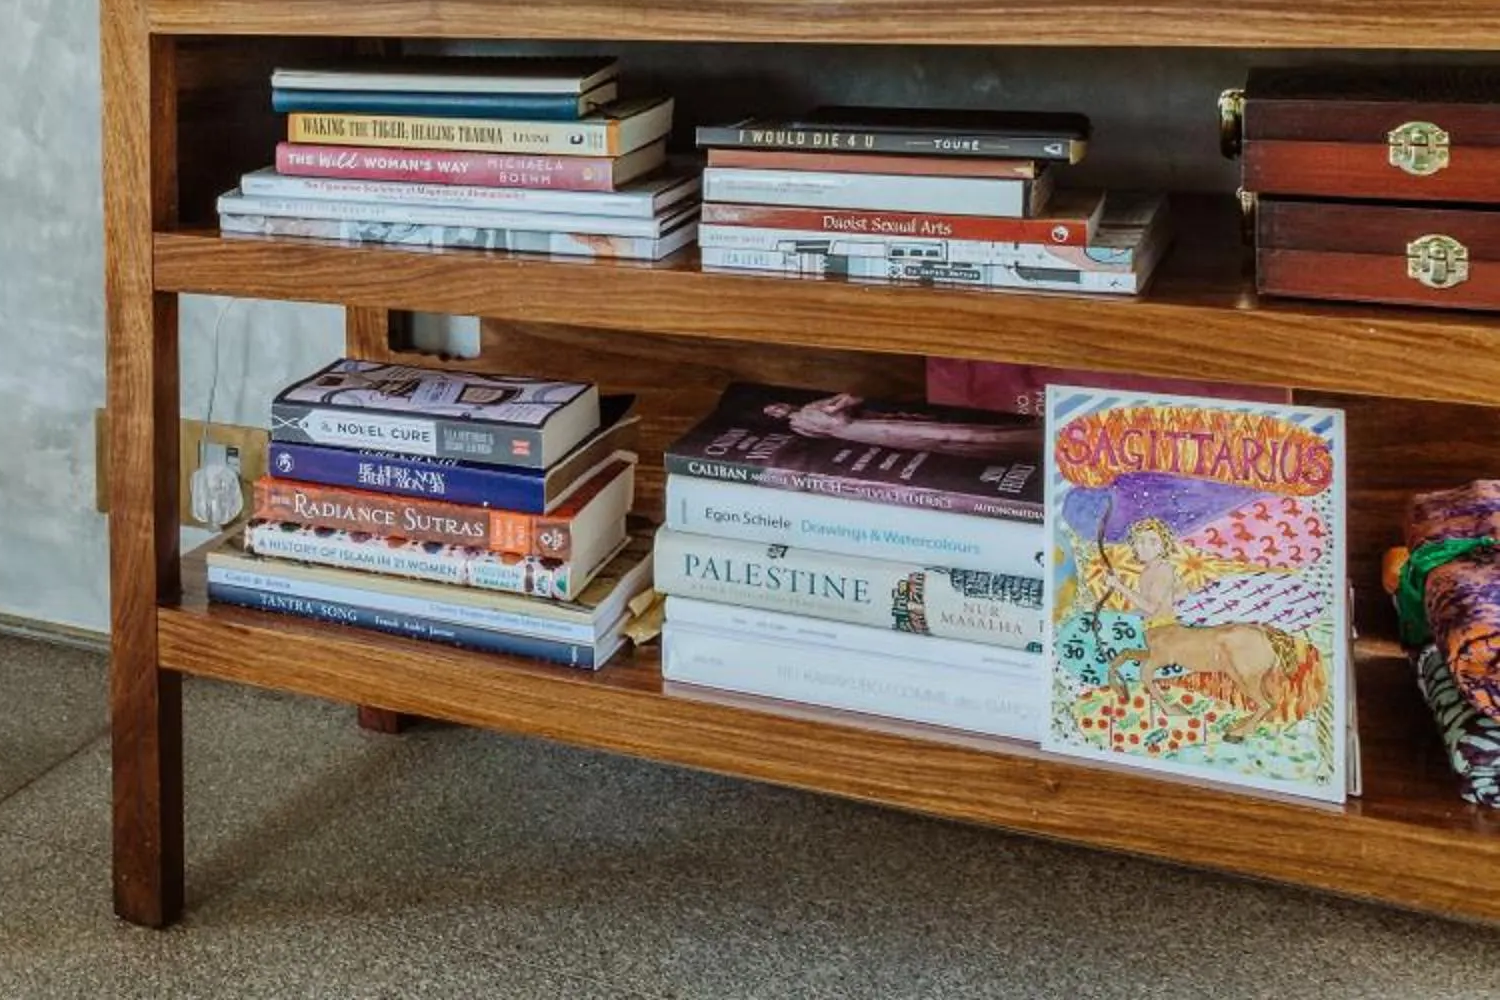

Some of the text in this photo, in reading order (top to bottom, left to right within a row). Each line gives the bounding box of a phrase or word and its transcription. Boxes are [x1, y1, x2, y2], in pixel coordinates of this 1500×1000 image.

[302, 117, 345, 137] WAKING
[411, 123, 455, 142] HEALING
[459, 125, 503, 144] TRAUMA
[739, 129, 744, 143] I
[752, 130, 806, 145] WOULD
[813, 133, 840, 147] DIE
[847, 135, 855, 147] 4
[865, 135, 875, 148] U
[288, 153, 314, 165] THE
[438, 161, 469, 174] WAY
[487, 159, 564, 172] MICHAELA
[499, 172, 552, 185] BOEHM
[823, 215, 953, 236] Daoist Sexual Arts
[337, 422, 385, 438] NOVEL
[390, 428, 431, 443] CURE
[1056, 422, 1334, 487] SAGITTARIUS
[687, 461, 747, 481] CALIBAN
[790, 475, 842, 493] WITCH
[705, 507, 981, 554] Egon Schiele Drawings & Watercolours
[257, 538, 266, 547] A
[269, 539, 318, 556] HISTORY
[321, 548, 336, 557] OF
[339, 549, 374, 565] ISLAM
[377, 555, 391, 566] IN
[406, 558, 458, 577] WOMEN
[684, 553, 872, 604] PALESTINE
[259, 593, 313, 614] TANTRA
[321, 605, 358, 623] SONG
[963, 602, 1000, 618] NUR
[940, 611, 1023, 635] MASALHA
